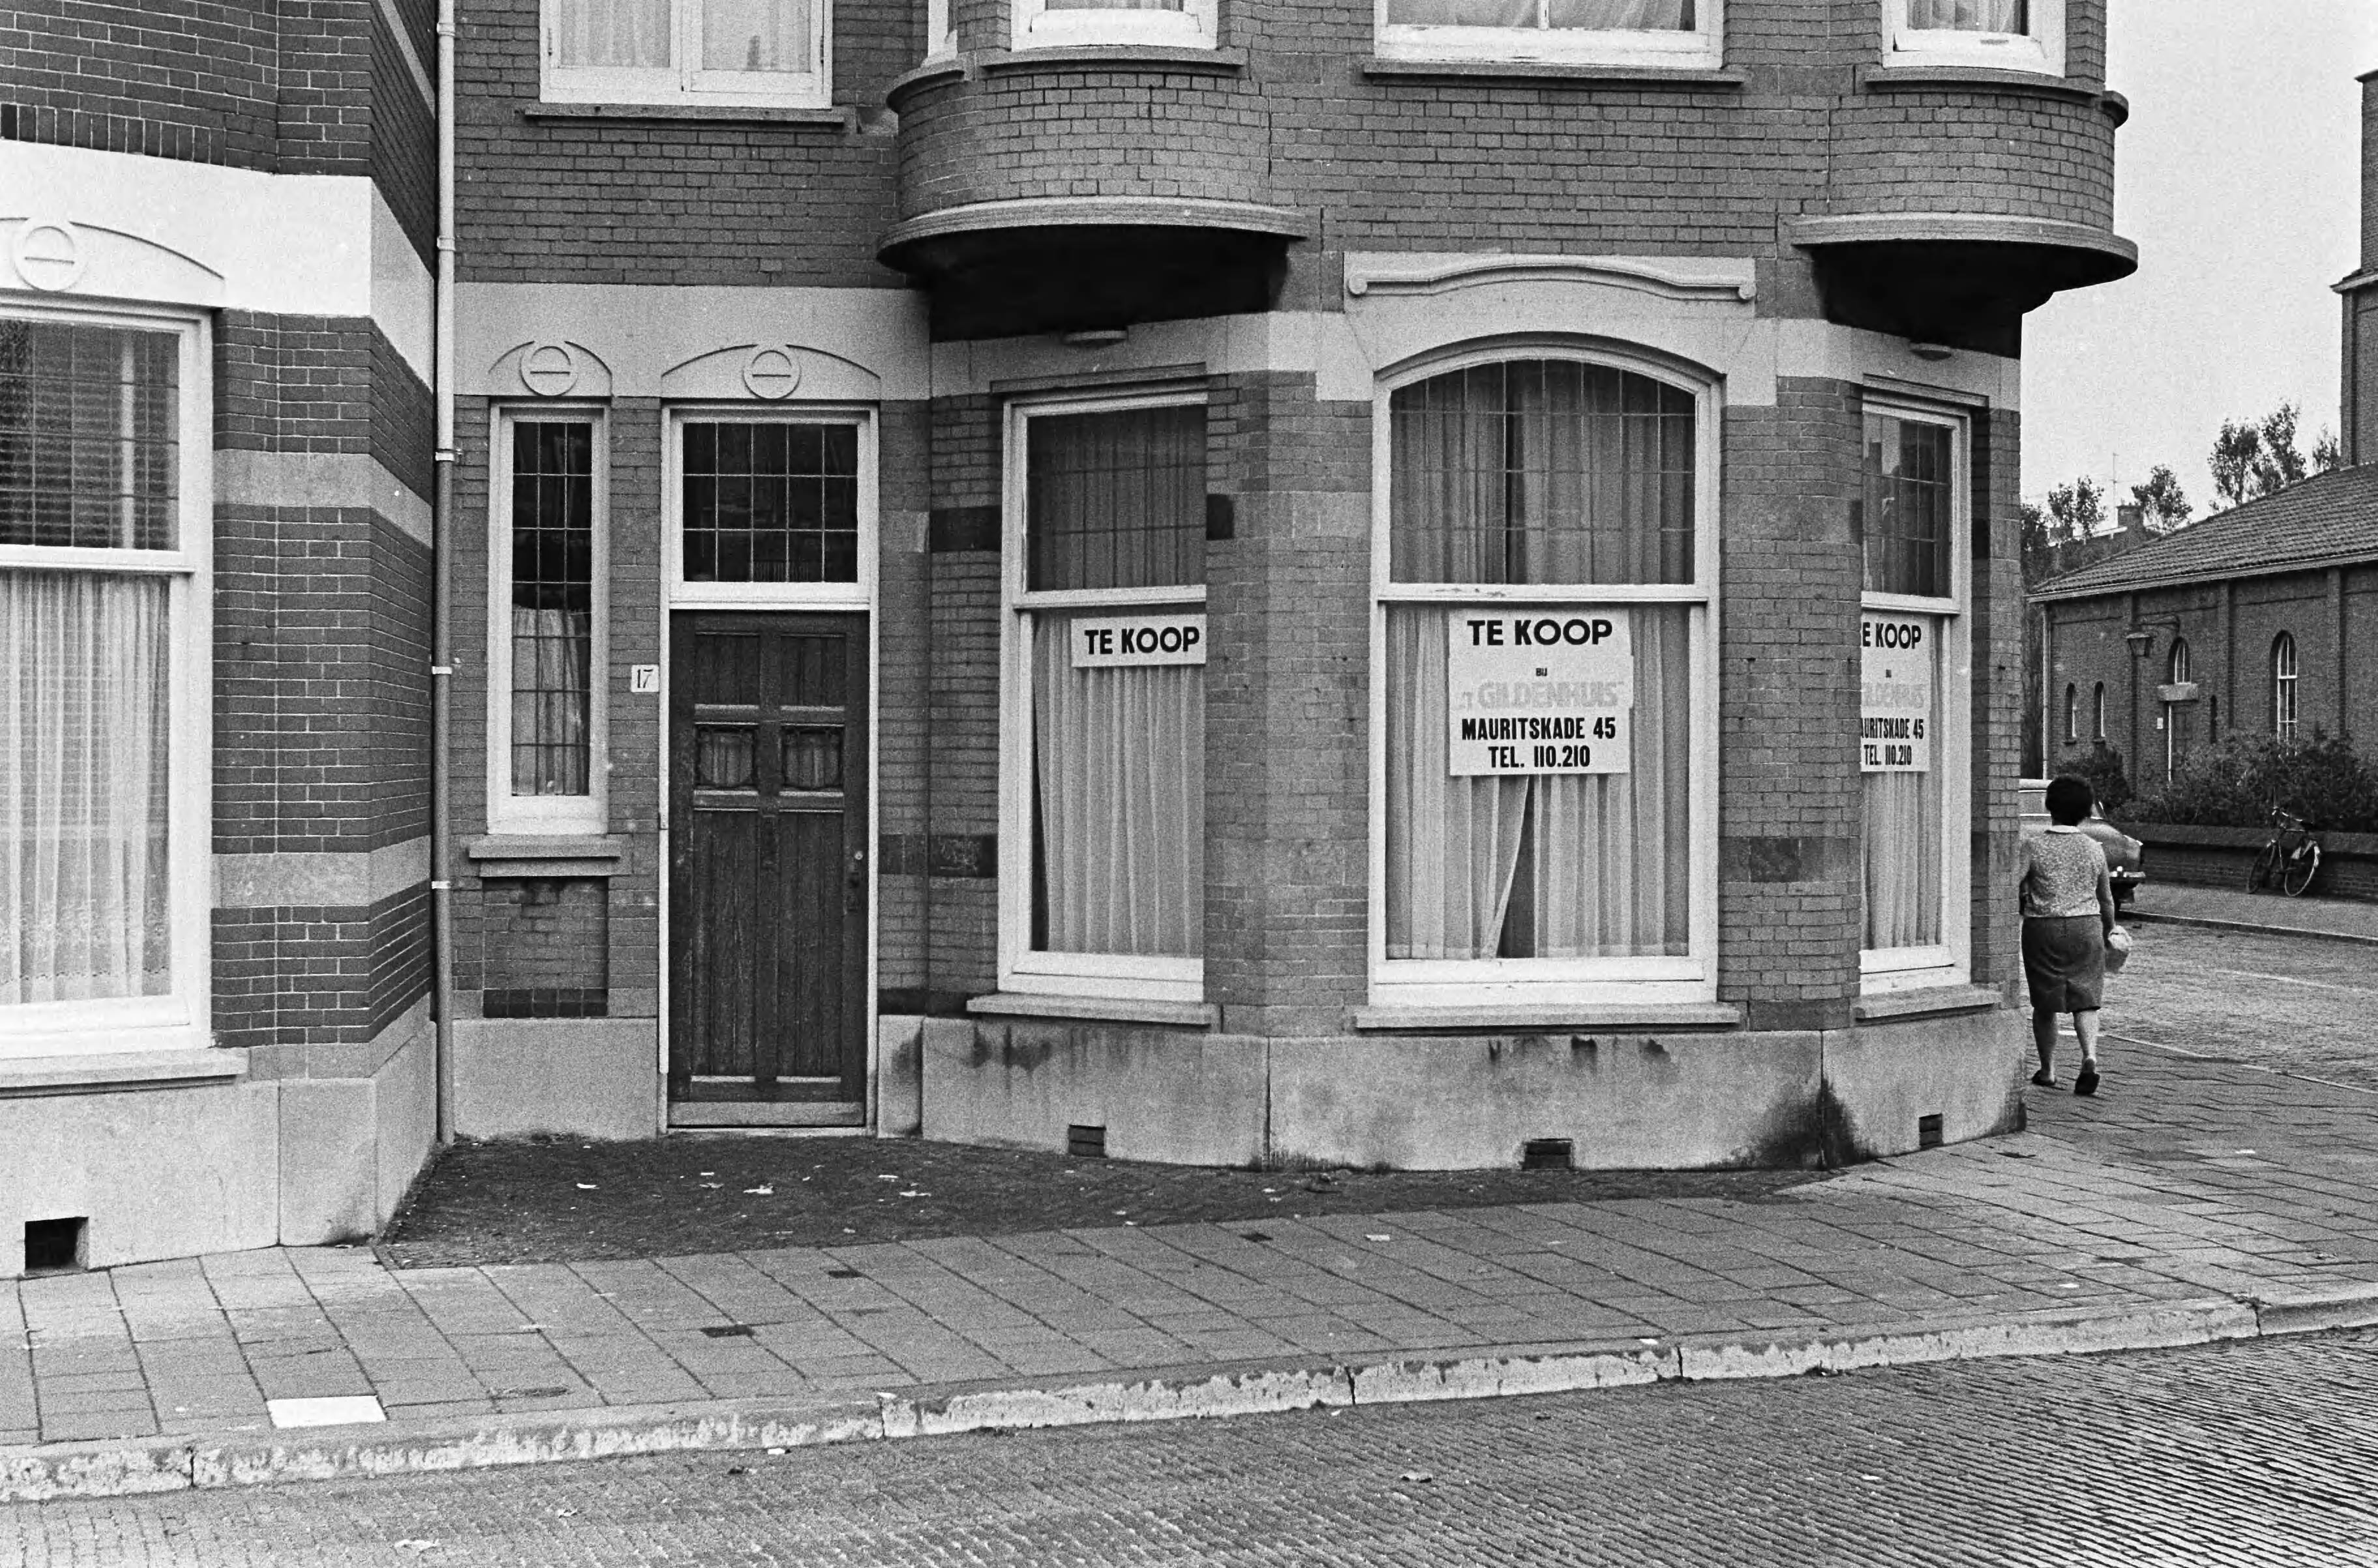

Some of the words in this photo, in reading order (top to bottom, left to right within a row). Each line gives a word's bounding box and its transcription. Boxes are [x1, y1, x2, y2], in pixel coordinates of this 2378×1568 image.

[1084, 628, 1113, 655] TE
[1121, 626, 1200, 654] KOOP
[1467, 620, 1504, 646] TE
[1514, 618, 1613, 646] KOOP
[1862, 622, 1872, 647] E
[1875, 622, 1922, 650] KOOP
[637, 669, 653, 689] 17
[1461, 717, 1585, 741] MAURITSKADE
[1593, 717, 1616, 740] 45
[1913, 718, 1924, 740] 45
[1488, 746, 1525, 768] TEL.
[1533, 745, 1591, 768] 110.210
[1863, 744, 1882, 766] TEL.
[1885, 744, 1912, 766] 110.210
